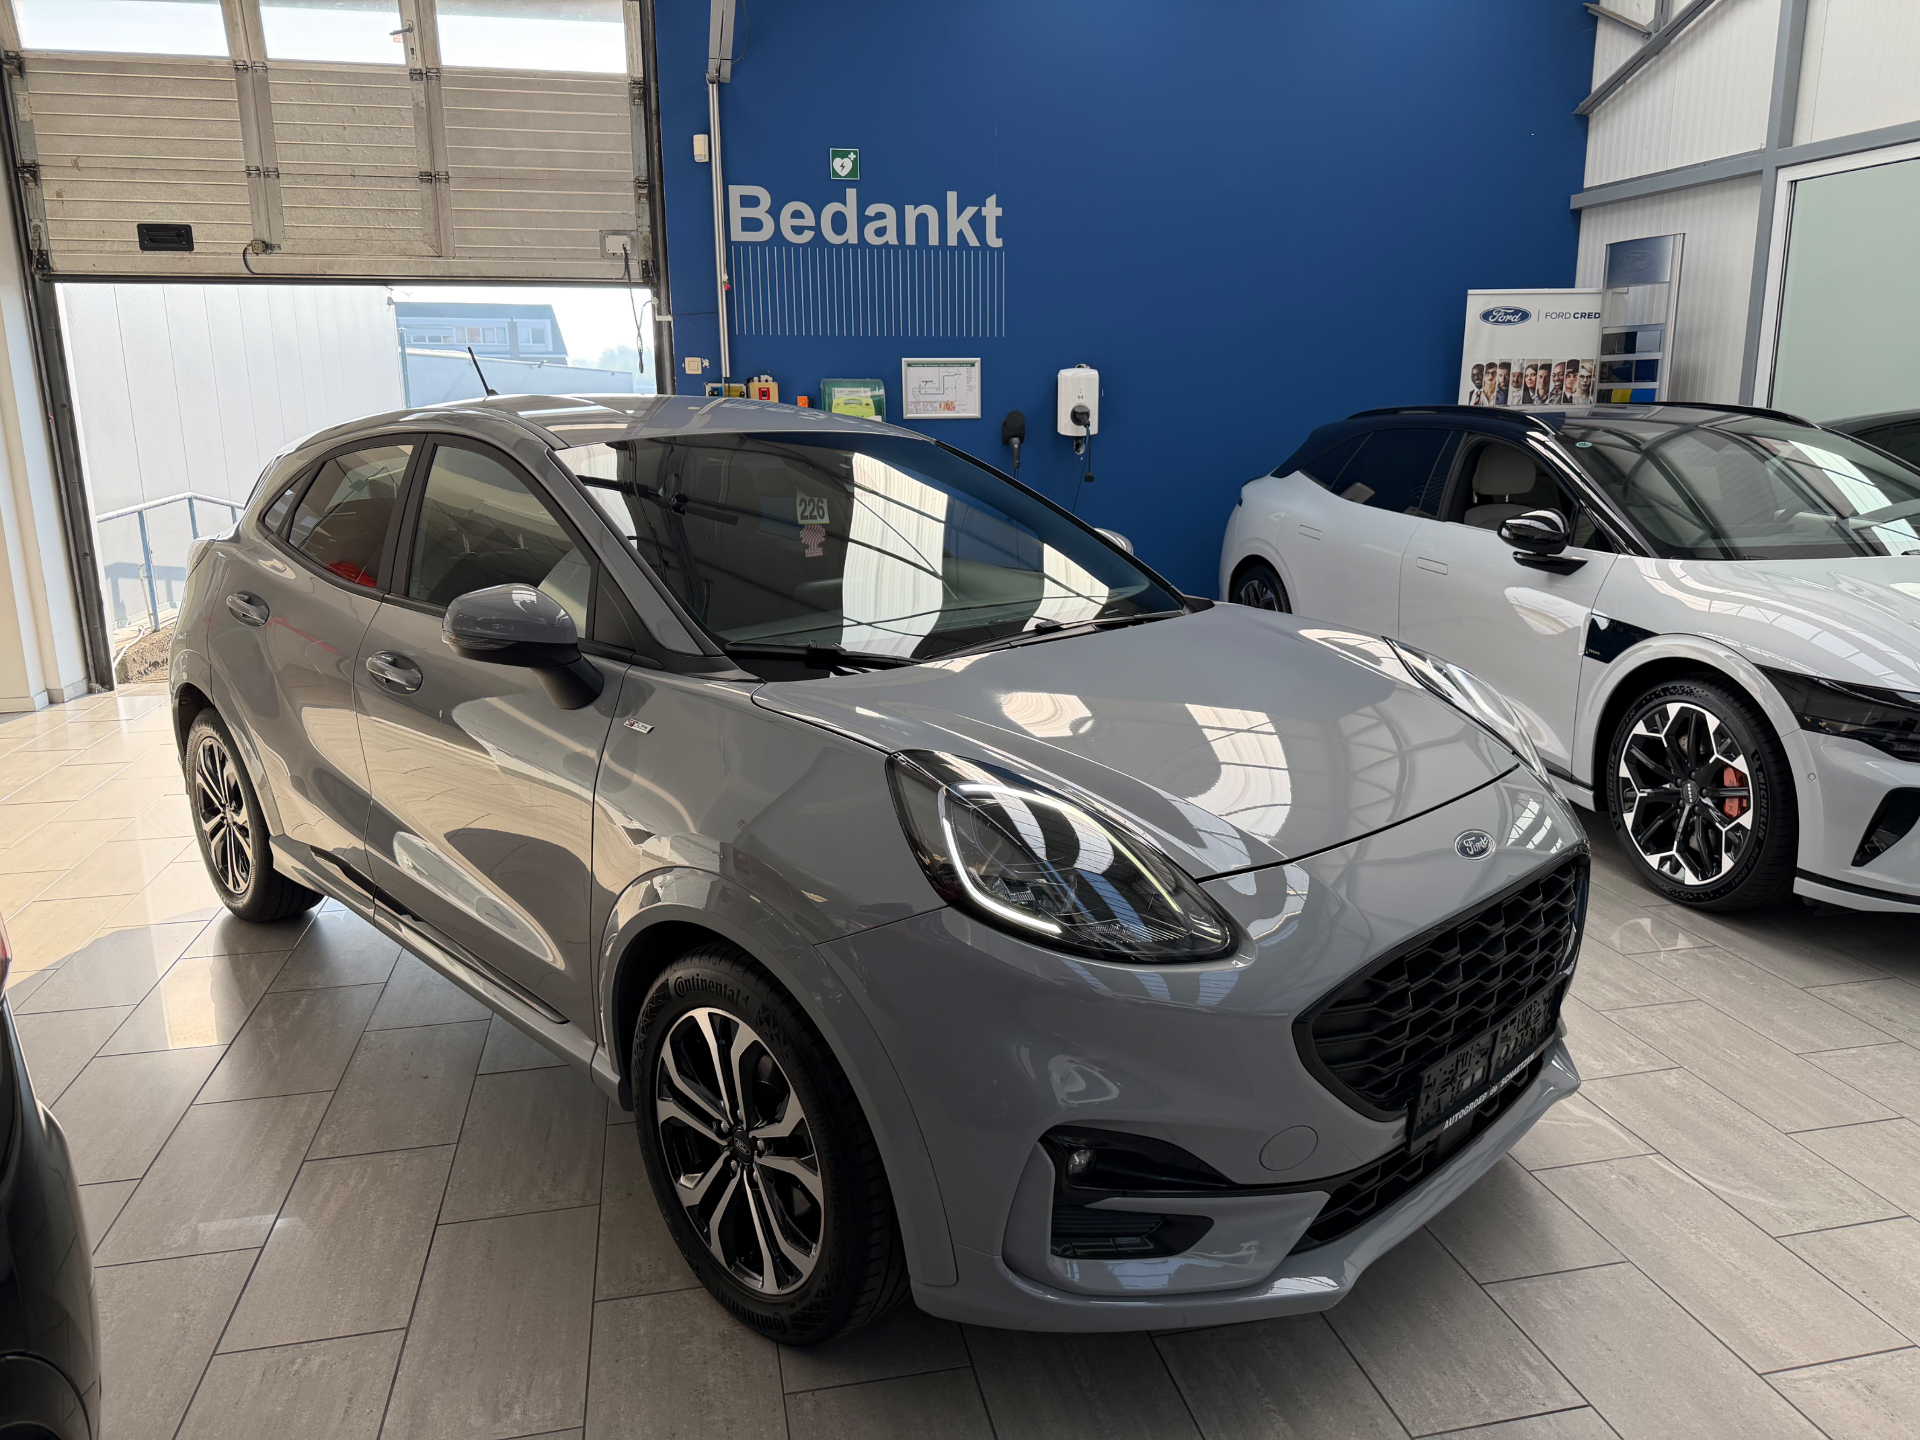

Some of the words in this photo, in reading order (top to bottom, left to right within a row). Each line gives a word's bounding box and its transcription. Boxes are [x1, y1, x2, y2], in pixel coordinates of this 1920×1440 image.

[727, 184, 1003, 248] Bedankt
[1488, 308, 1522, 323] Ford
[1544, 311, 1571, 320] FORD
[1573, 311, 1601, 320] CRED
[798, 497, 825, 521] 226
[1757, 771, 1768, 842] MICHELIN
[1746, 846, 1759, 869] PILOT
[1731, 867, 1748, 888] SPORT
[674, 973, 741, 1006] Continental
[1443, 1092, 1488, 1131] AUTOGROEP
[716, 1286, 787, 1335] Continental
